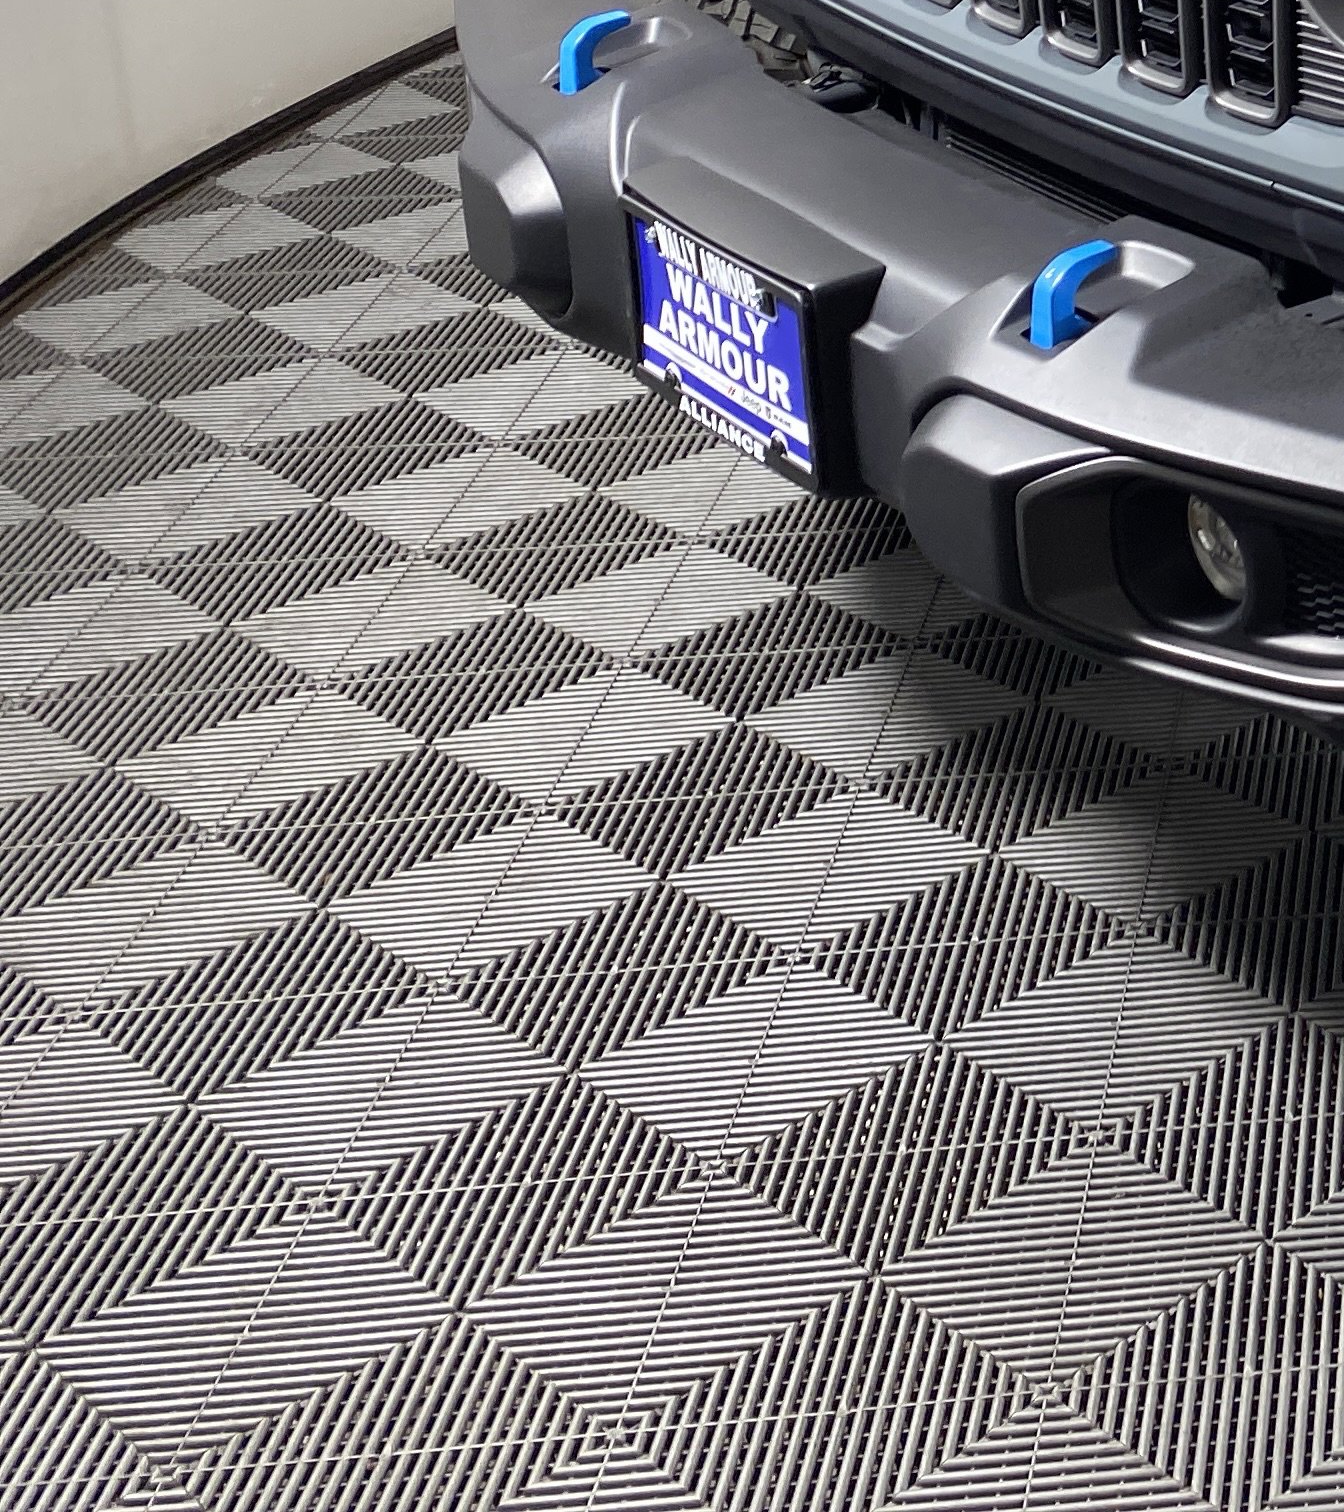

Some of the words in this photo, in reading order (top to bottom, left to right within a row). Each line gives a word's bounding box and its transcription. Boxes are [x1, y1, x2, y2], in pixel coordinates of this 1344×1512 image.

[654, 221, 697, 275] WALLY
[699, 248, 759, 306] ARMOUR
[666, 263, 769, 354] WALLY
[659, 300, 792, 411] ARMOUR
[679, 395, 766, 462] ALLIANCE
